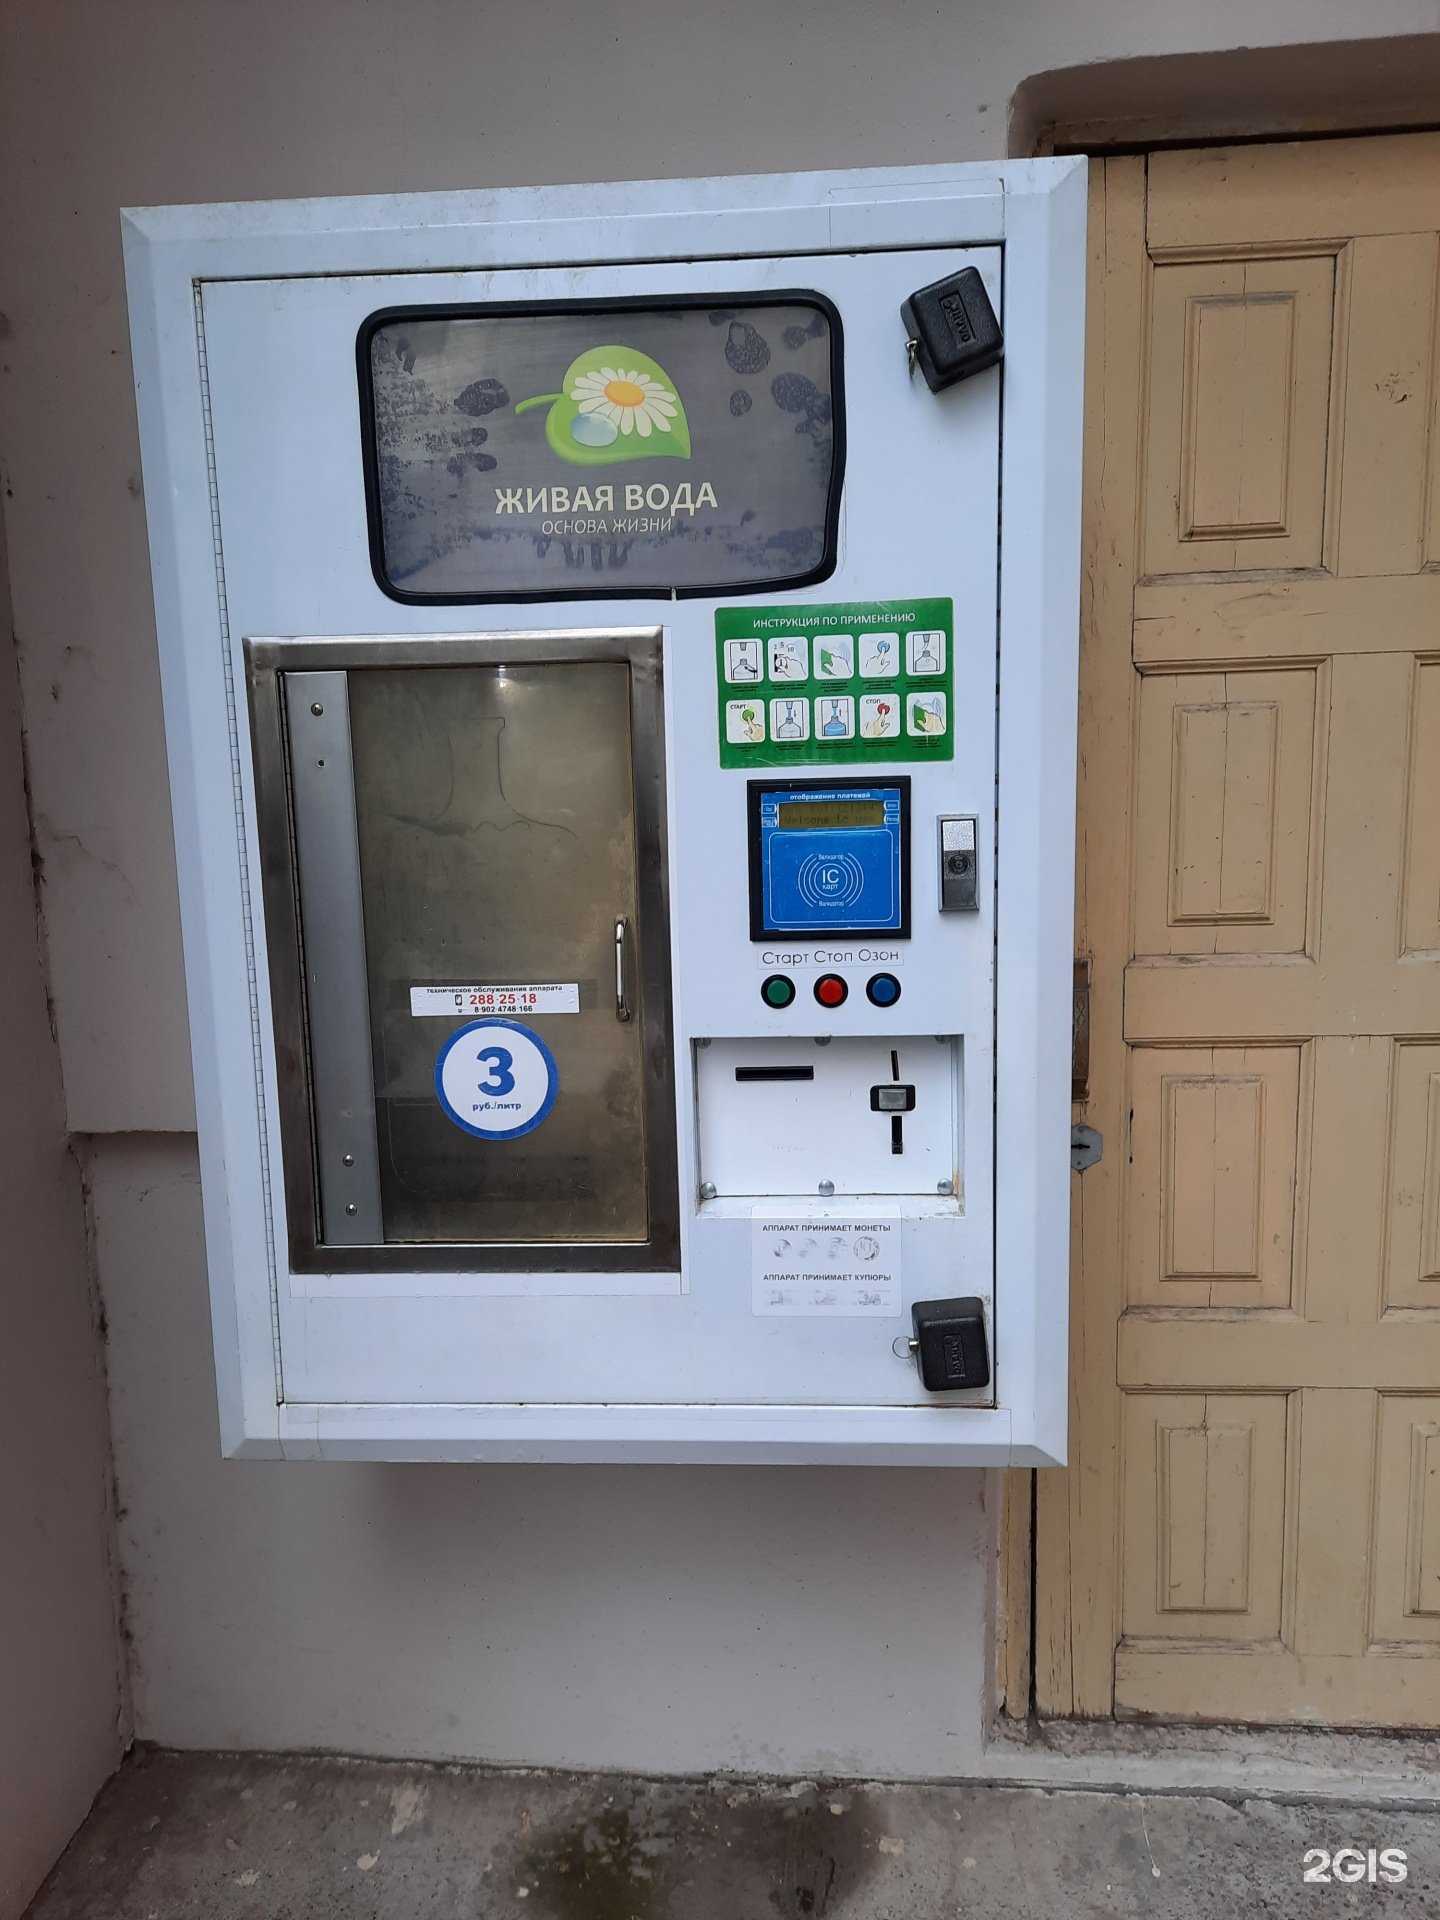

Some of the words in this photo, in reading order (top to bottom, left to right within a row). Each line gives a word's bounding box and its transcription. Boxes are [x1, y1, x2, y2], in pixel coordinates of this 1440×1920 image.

[495, 485, 614, 514] ЖИВАЯ
[624, 482, 719, 517] ВОДА
[542, 518, 607, 535] ОСНОВА
[612, 517, 672, 533] ЖИЗНИ
[753, 616, 820, 628] ИНСТРУКЦИЯ
[822, 616, 838, 625] ПО
[840, 612, 916, 625] ПРИМЕНЕНИЮ
[822, 869, 839, 883] IC
[762, 951, 809, 966] Старт
[814, 950, 853, 963] Стоп
[858, 948, 899, 961] Озон
[476, 1046, 516, 1097] 3
[762, 1224, 799, 1232] АППАРАТ
[801, 1224, 851, 1232] ПРИНИМАЕТ
[854, 1224, 891, 1232] МОНЕТЫ
[763, 1273, 800, 1281] АППАРАТ
[802, 1273, 851, 1281] ПРИНИМАЕТ
[854, 1273, 892, 1281] КУПЮРЫ
